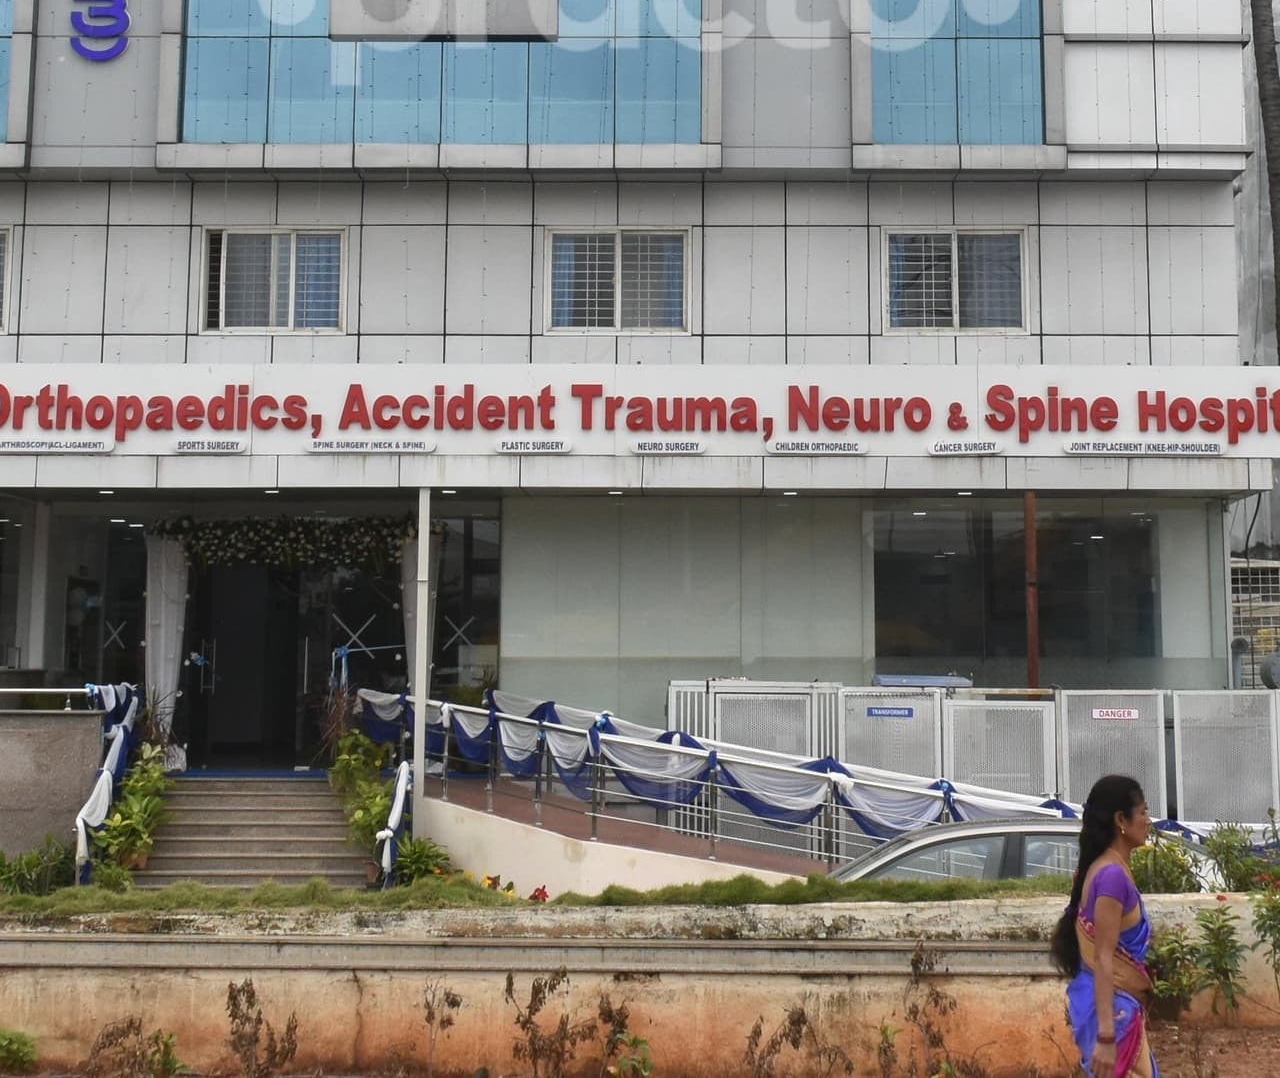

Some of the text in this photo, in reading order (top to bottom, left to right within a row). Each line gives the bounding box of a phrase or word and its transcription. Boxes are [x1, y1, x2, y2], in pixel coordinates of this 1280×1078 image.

[339, 383, 556, 430] Accident
[571, 383, 775, 438] Trauma,
[788, 385, 933, 432] Neuro
[948, 402, 969, 431] &
[986, 384, 1119, 443] Spine
[177, 441, 240, 451] SPORTS SURGERY
[312, 441, 334, 450] SPINE
[335, 441, 369, 450] SURGERY
[370, 441, 394, 451] (NECK
[402, 441, 426, 451] SPINE)
[501, 441, 565, 451] PLASTIC SURGERY
[637, 441, 700, 451] NEURO SURGERY
[775, 442, 859, 451] CHILDREN ORTHOPAEDIC
[934, 441, 997, 453] CANCER SURGERY
[1070, 442, 1091, 451] JOINT
[1092, 442, 1143, 452] REPLACEMENT
[1099, 709, 1133, 719] DANGER
